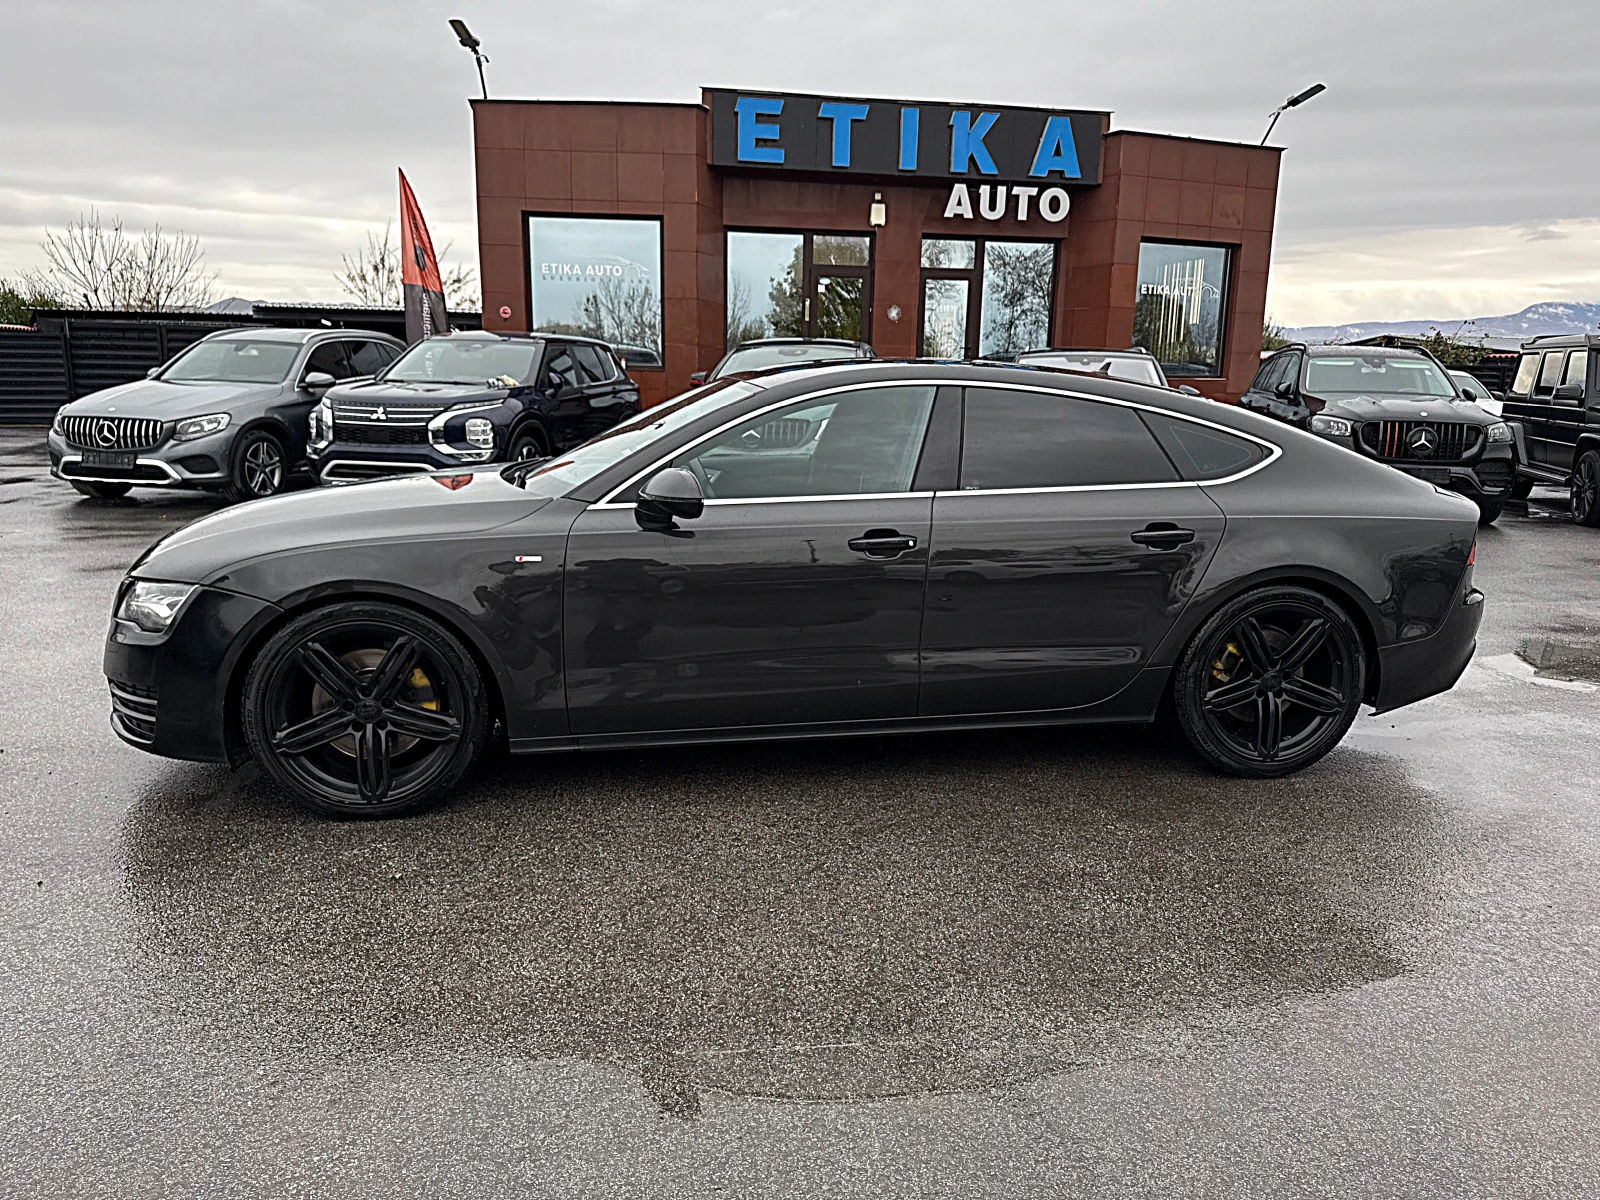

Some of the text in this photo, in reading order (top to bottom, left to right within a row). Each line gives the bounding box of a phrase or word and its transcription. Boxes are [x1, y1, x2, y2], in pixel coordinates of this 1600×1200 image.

[734, 97, 1081, 178] ETIKA
[943, 182, 1071, 222] AUTO
[541, 263, 623, 276] ETIKA AUTO
[1141, 284, 1170, 295] ETIKA
